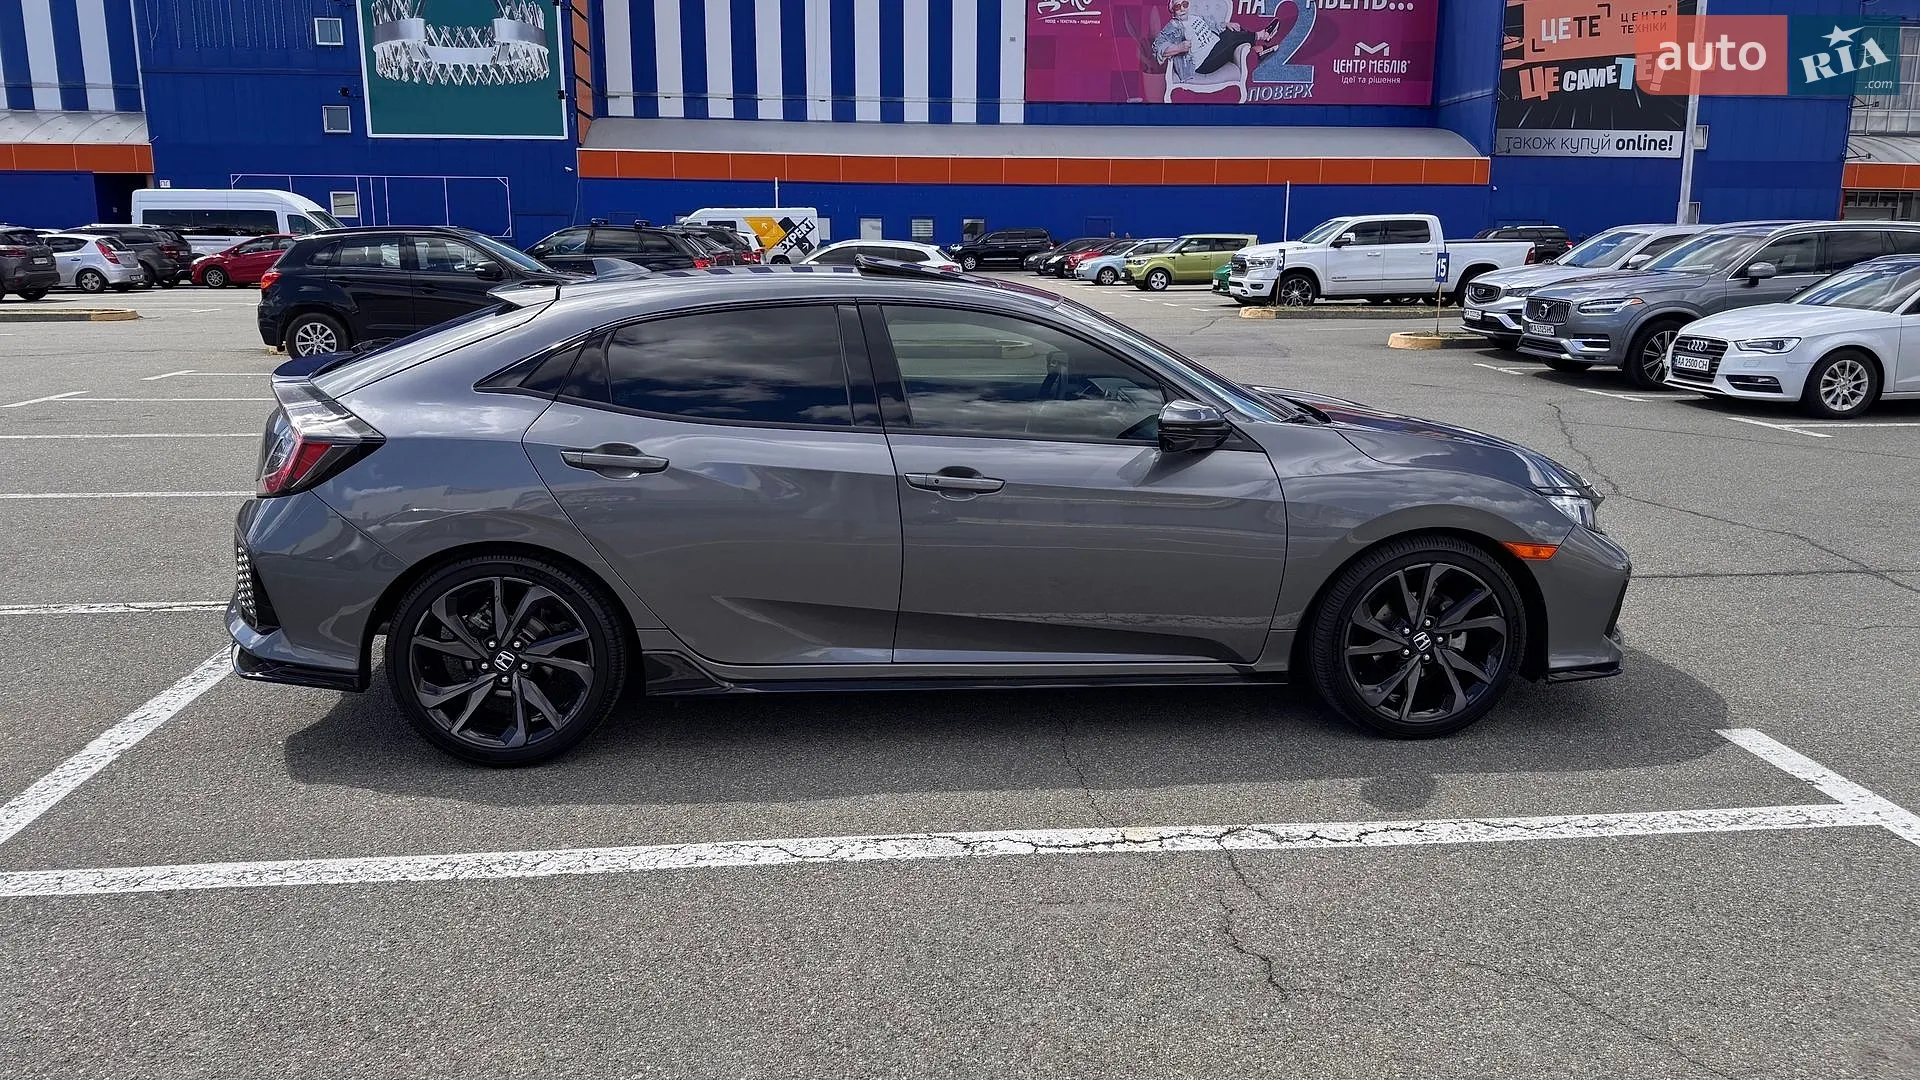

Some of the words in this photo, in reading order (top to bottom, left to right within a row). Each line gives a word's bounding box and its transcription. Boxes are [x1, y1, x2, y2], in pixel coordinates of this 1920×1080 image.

[1621, 10, 1668, 23] ЦЕНТР
[1541, 15, 1601, 43] ЦЕТЕ
[1621, 22, 1668, 34] ТЕХНІКИ
[1333, 59, 1366, 74] ЦЕНТР
[1368, 59, 1407, 74] МЕБЛІВ
[1368, 75, 1401, 85] рішення
[1518, 66, 1560, 101] ЦЕ
[1562, 65, 1618, 92] САМЕ
[1249, 83, 1314, 101] ПОВЕРХ
[1505, 135, 1556, 150] також
[1561, 134, 1611, 154] купуй
[1615, 134, 1674, 151] online!
[780, 219, 814, 253] EXPERT
[1436, 257, 1447, 277] 15
